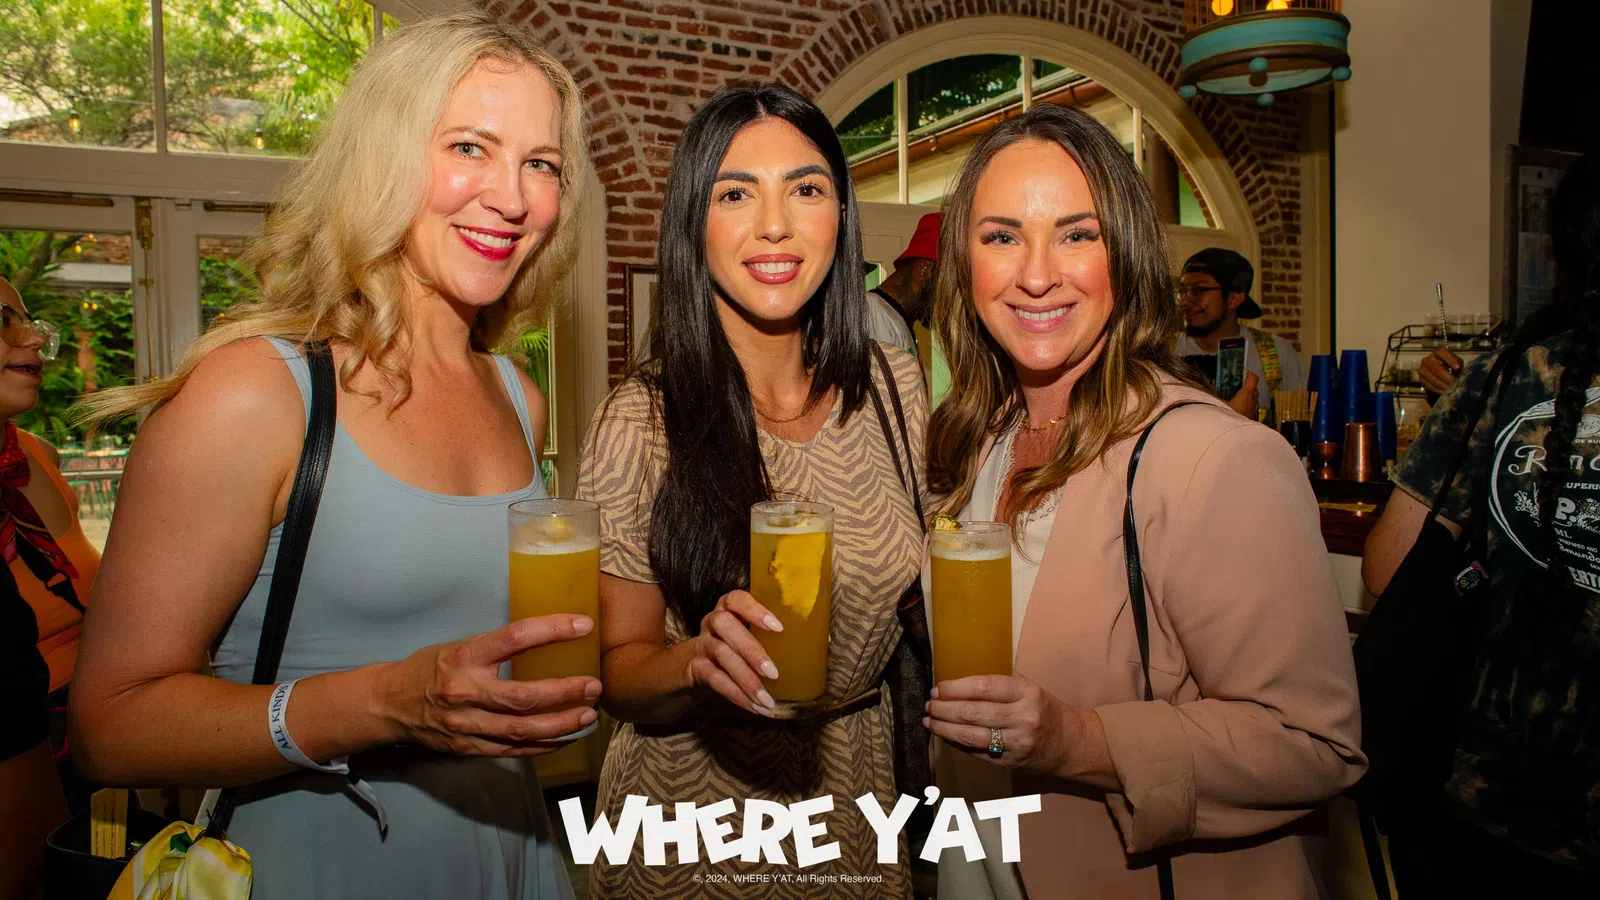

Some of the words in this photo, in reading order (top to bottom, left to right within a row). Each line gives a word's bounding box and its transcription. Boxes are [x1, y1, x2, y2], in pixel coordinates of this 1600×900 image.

[1564, 482, 1600, 491] UPERI
[271, 684, 289, 723] KINDS
[274, 725, 292, 749] ALL
